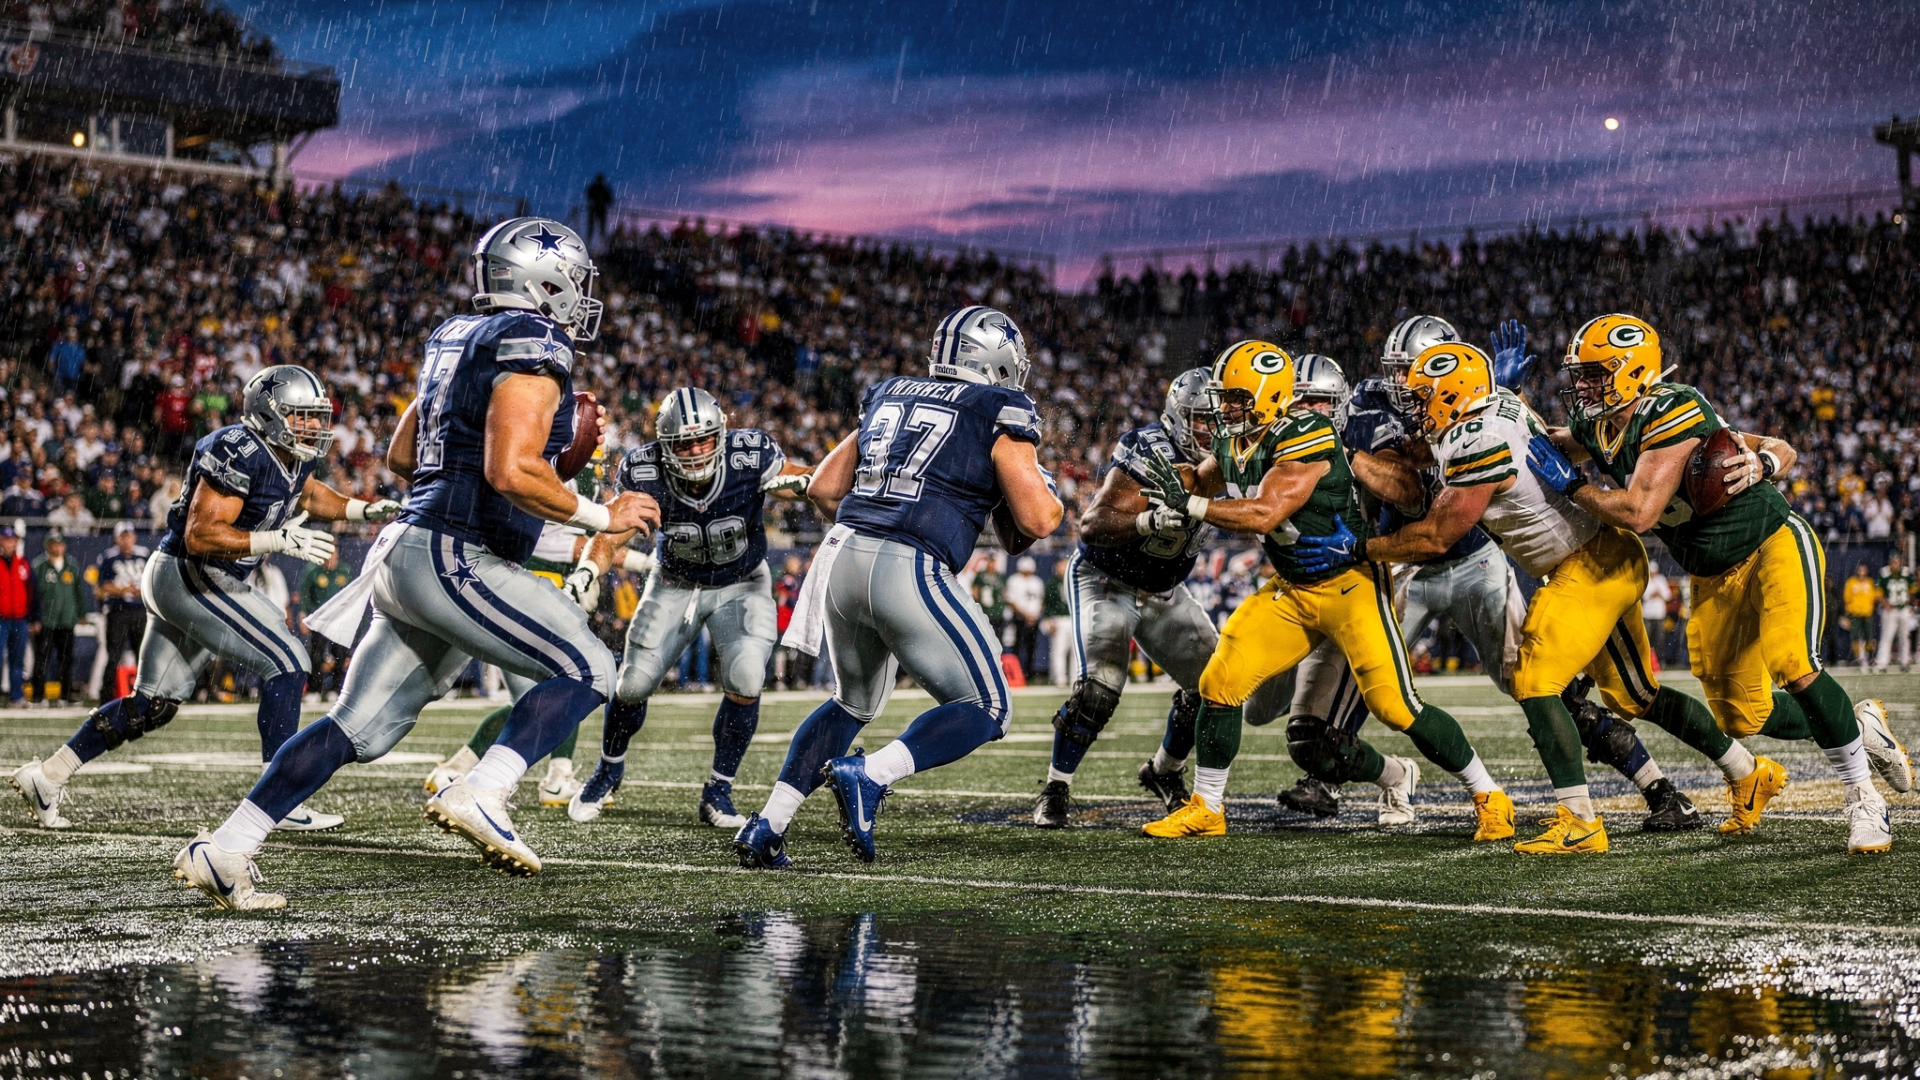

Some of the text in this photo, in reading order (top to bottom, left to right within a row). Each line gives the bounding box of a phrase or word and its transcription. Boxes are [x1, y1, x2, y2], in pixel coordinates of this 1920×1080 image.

[1607, 324, 1645, 348] G
[1251, 351, 1285, 374] G
[1423, 352, 1459, 377] G
[730, 431, 762, 470] 22
[852, 401, 959, 502] 37
